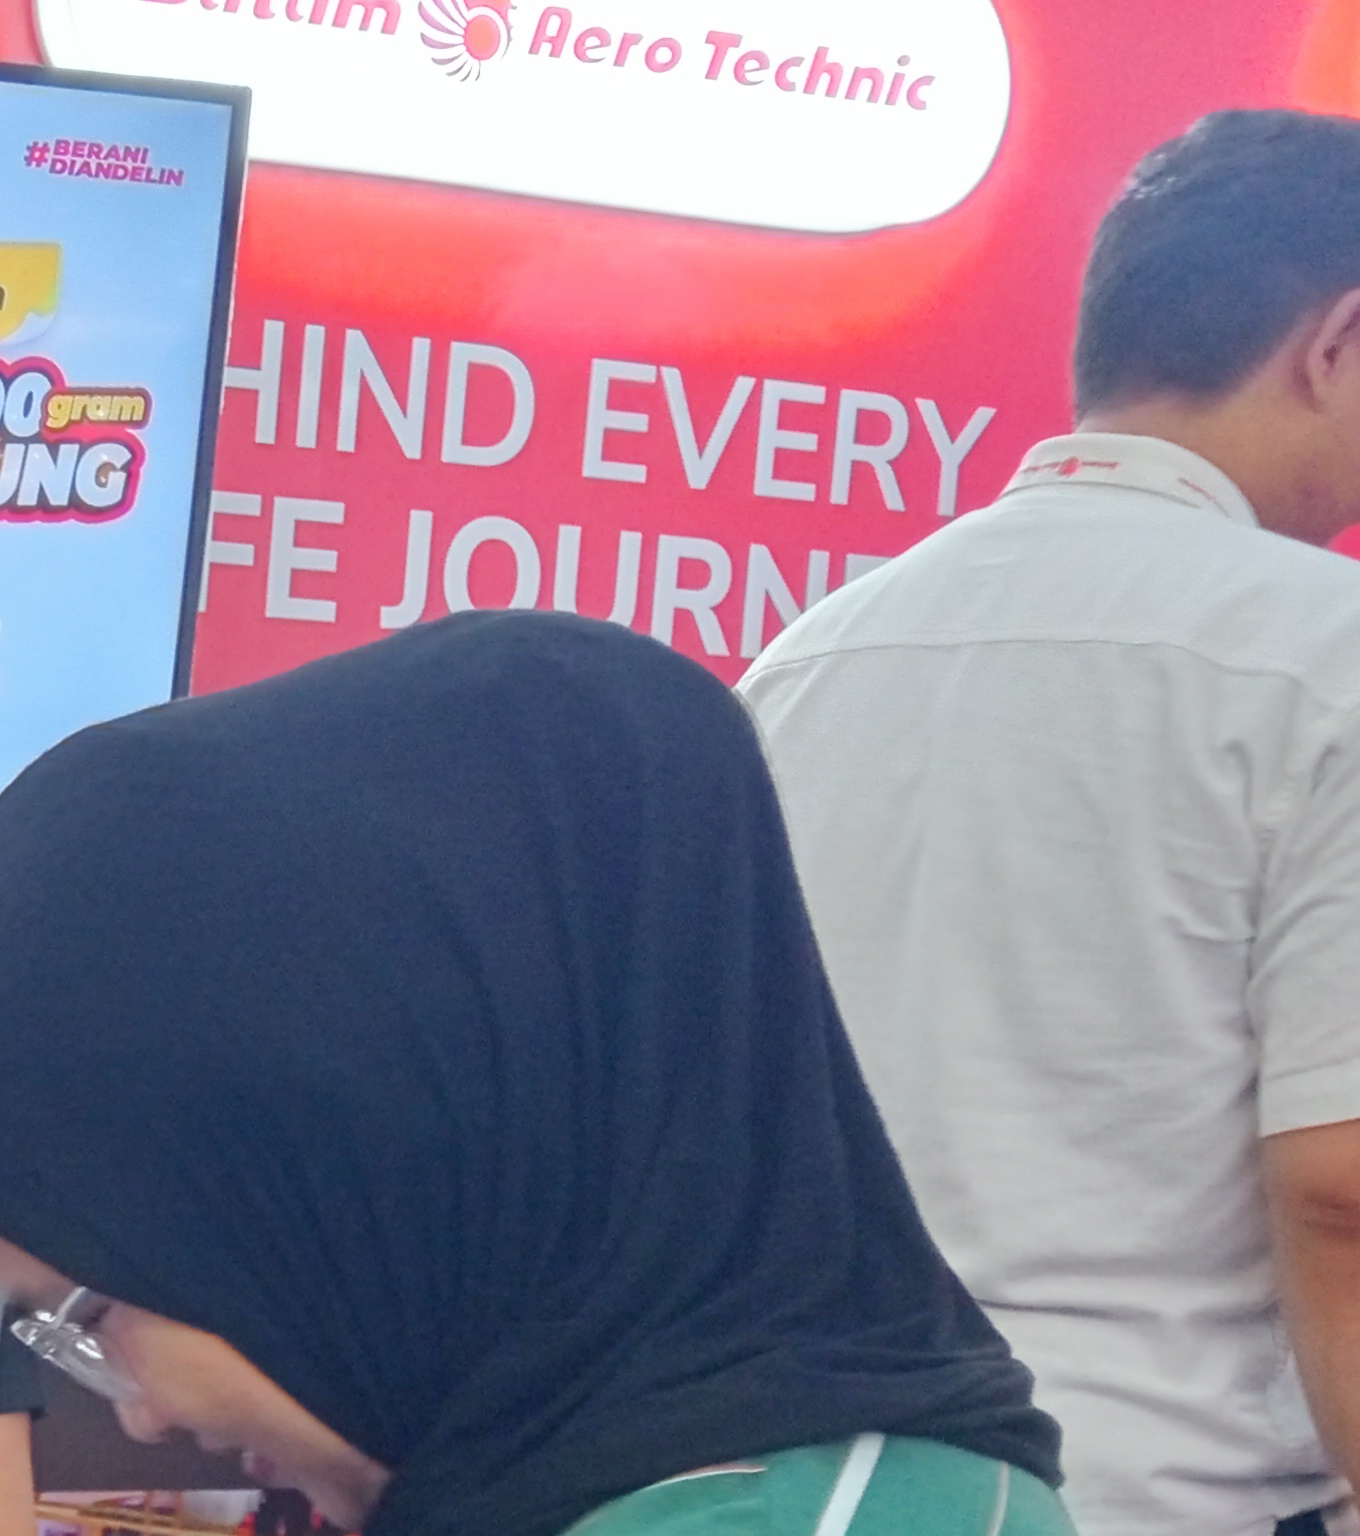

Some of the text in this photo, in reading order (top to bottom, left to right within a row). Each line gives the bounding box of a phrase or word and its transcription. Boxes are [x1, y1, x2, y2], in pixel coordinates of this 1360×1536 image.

[527, 5, 936, 111] Aero Technic
[48, 157, 185, 187] DIANDELIN
[580, 357, 997, 517] EVERY
